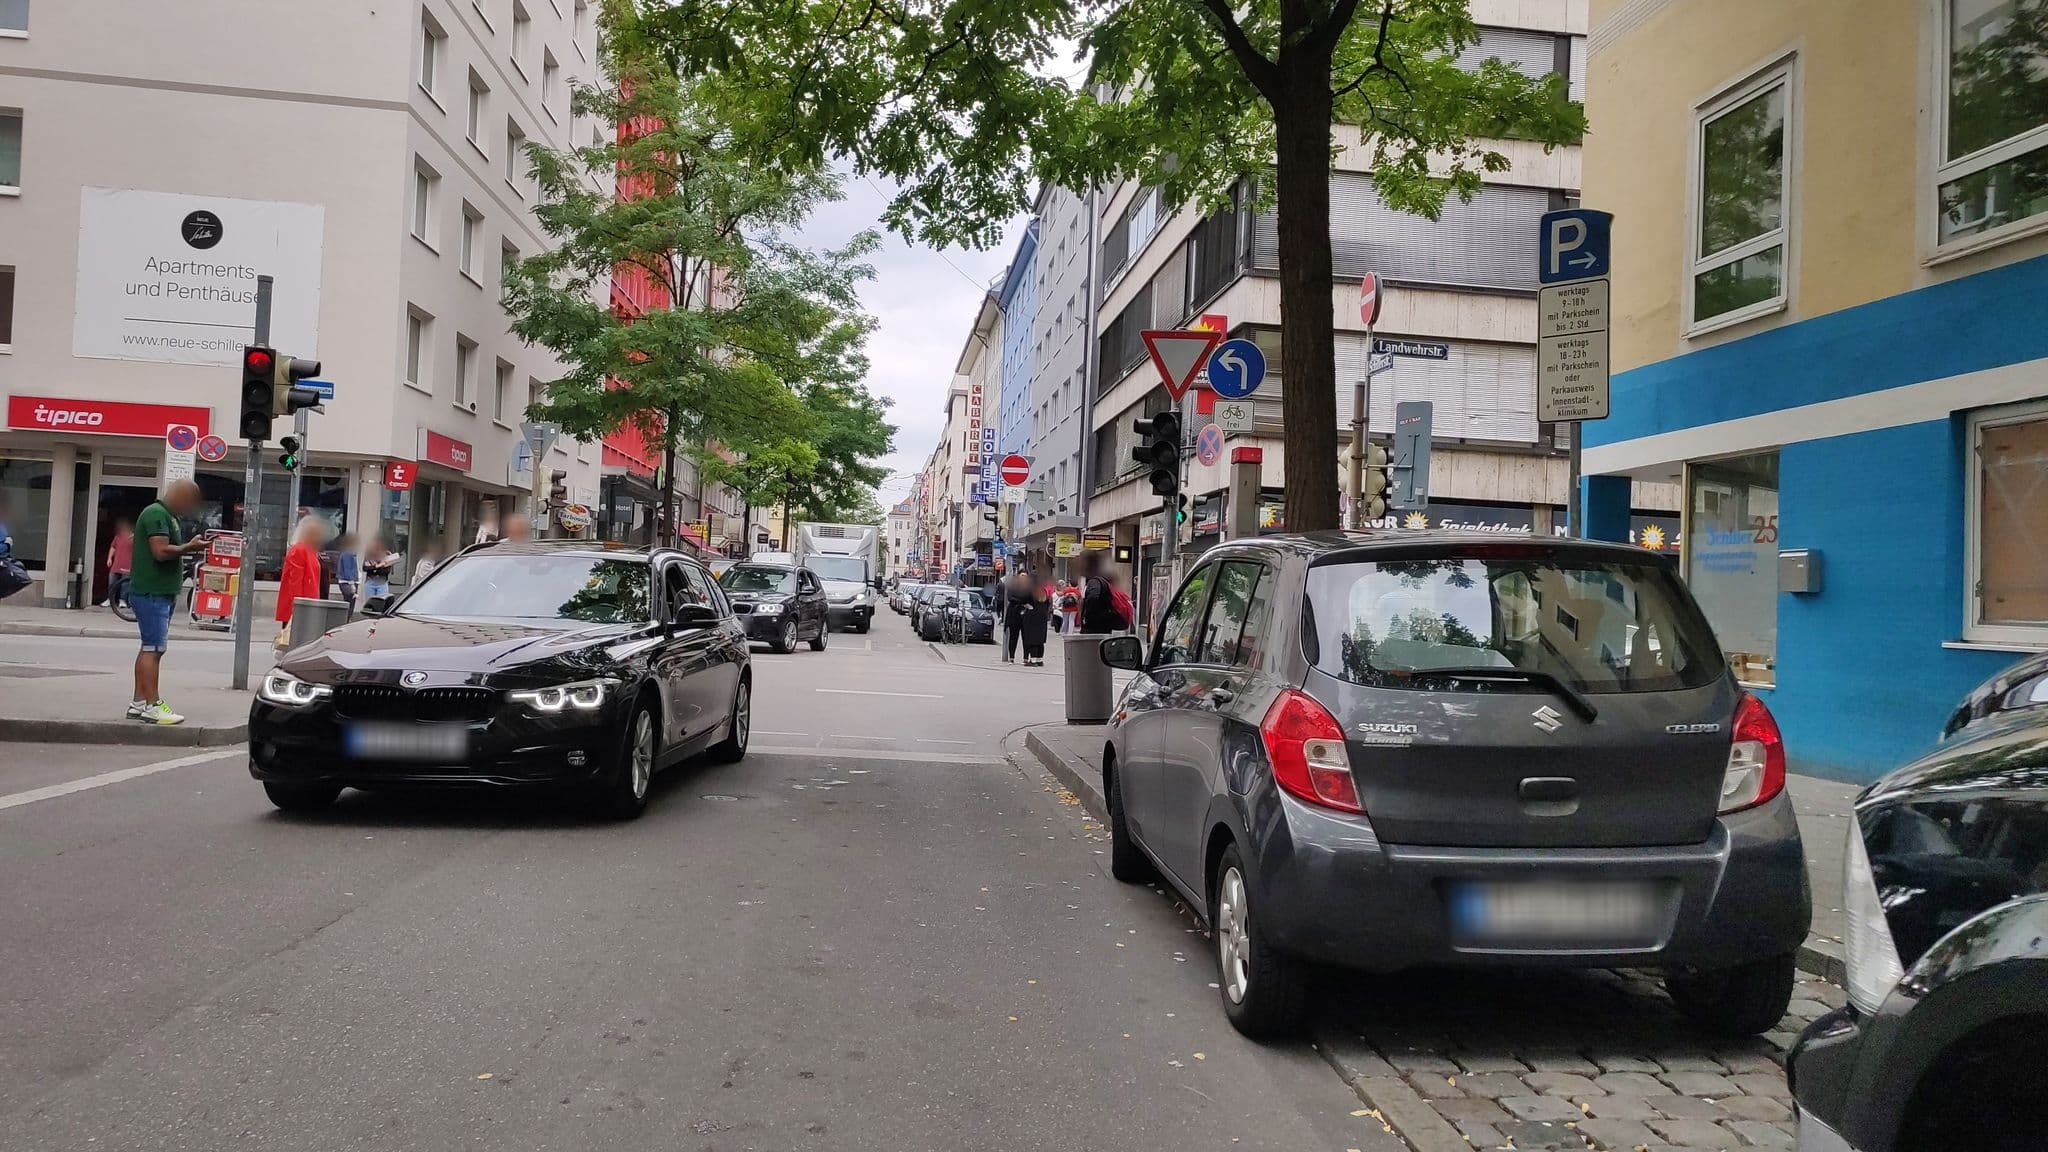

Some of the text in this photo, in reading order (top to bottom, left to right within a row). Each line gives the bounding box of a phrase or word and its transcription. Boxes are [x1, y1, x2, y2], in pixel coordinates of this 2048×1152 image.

[1550, 217, 1587, 274] P
[144, 256, 255, 280] Apartments
[125, 282, 161, 297] und
[1557, 287, 1590, 297] werktags
[1547, 308, 1600, 321] mit Parkschein
[1556, 323, 1566, 332] bis
[1569, 321, 1574, 330] 2
[1379, 340, 1443, 357] Landwehrstr.
[1557, 340, 1590, 349] werktags
[1546, 361, 1600, 373] mit Parkschein
[1564, 374, 1581, 383] oder
[1551, 384, 1595, 395] Parkausweis
[34, 404, 103, 426] tipico
[1557, 408, 1588, 417] klinikum
[969, 385, 981, 462] CABARET
[1226, 421, 1240, 430] frei
[983, 429, 994, 490] HOTEL
[1753, 515, 1778, 544] 25
[1358, 723, 1418, 734] SUZUKI
